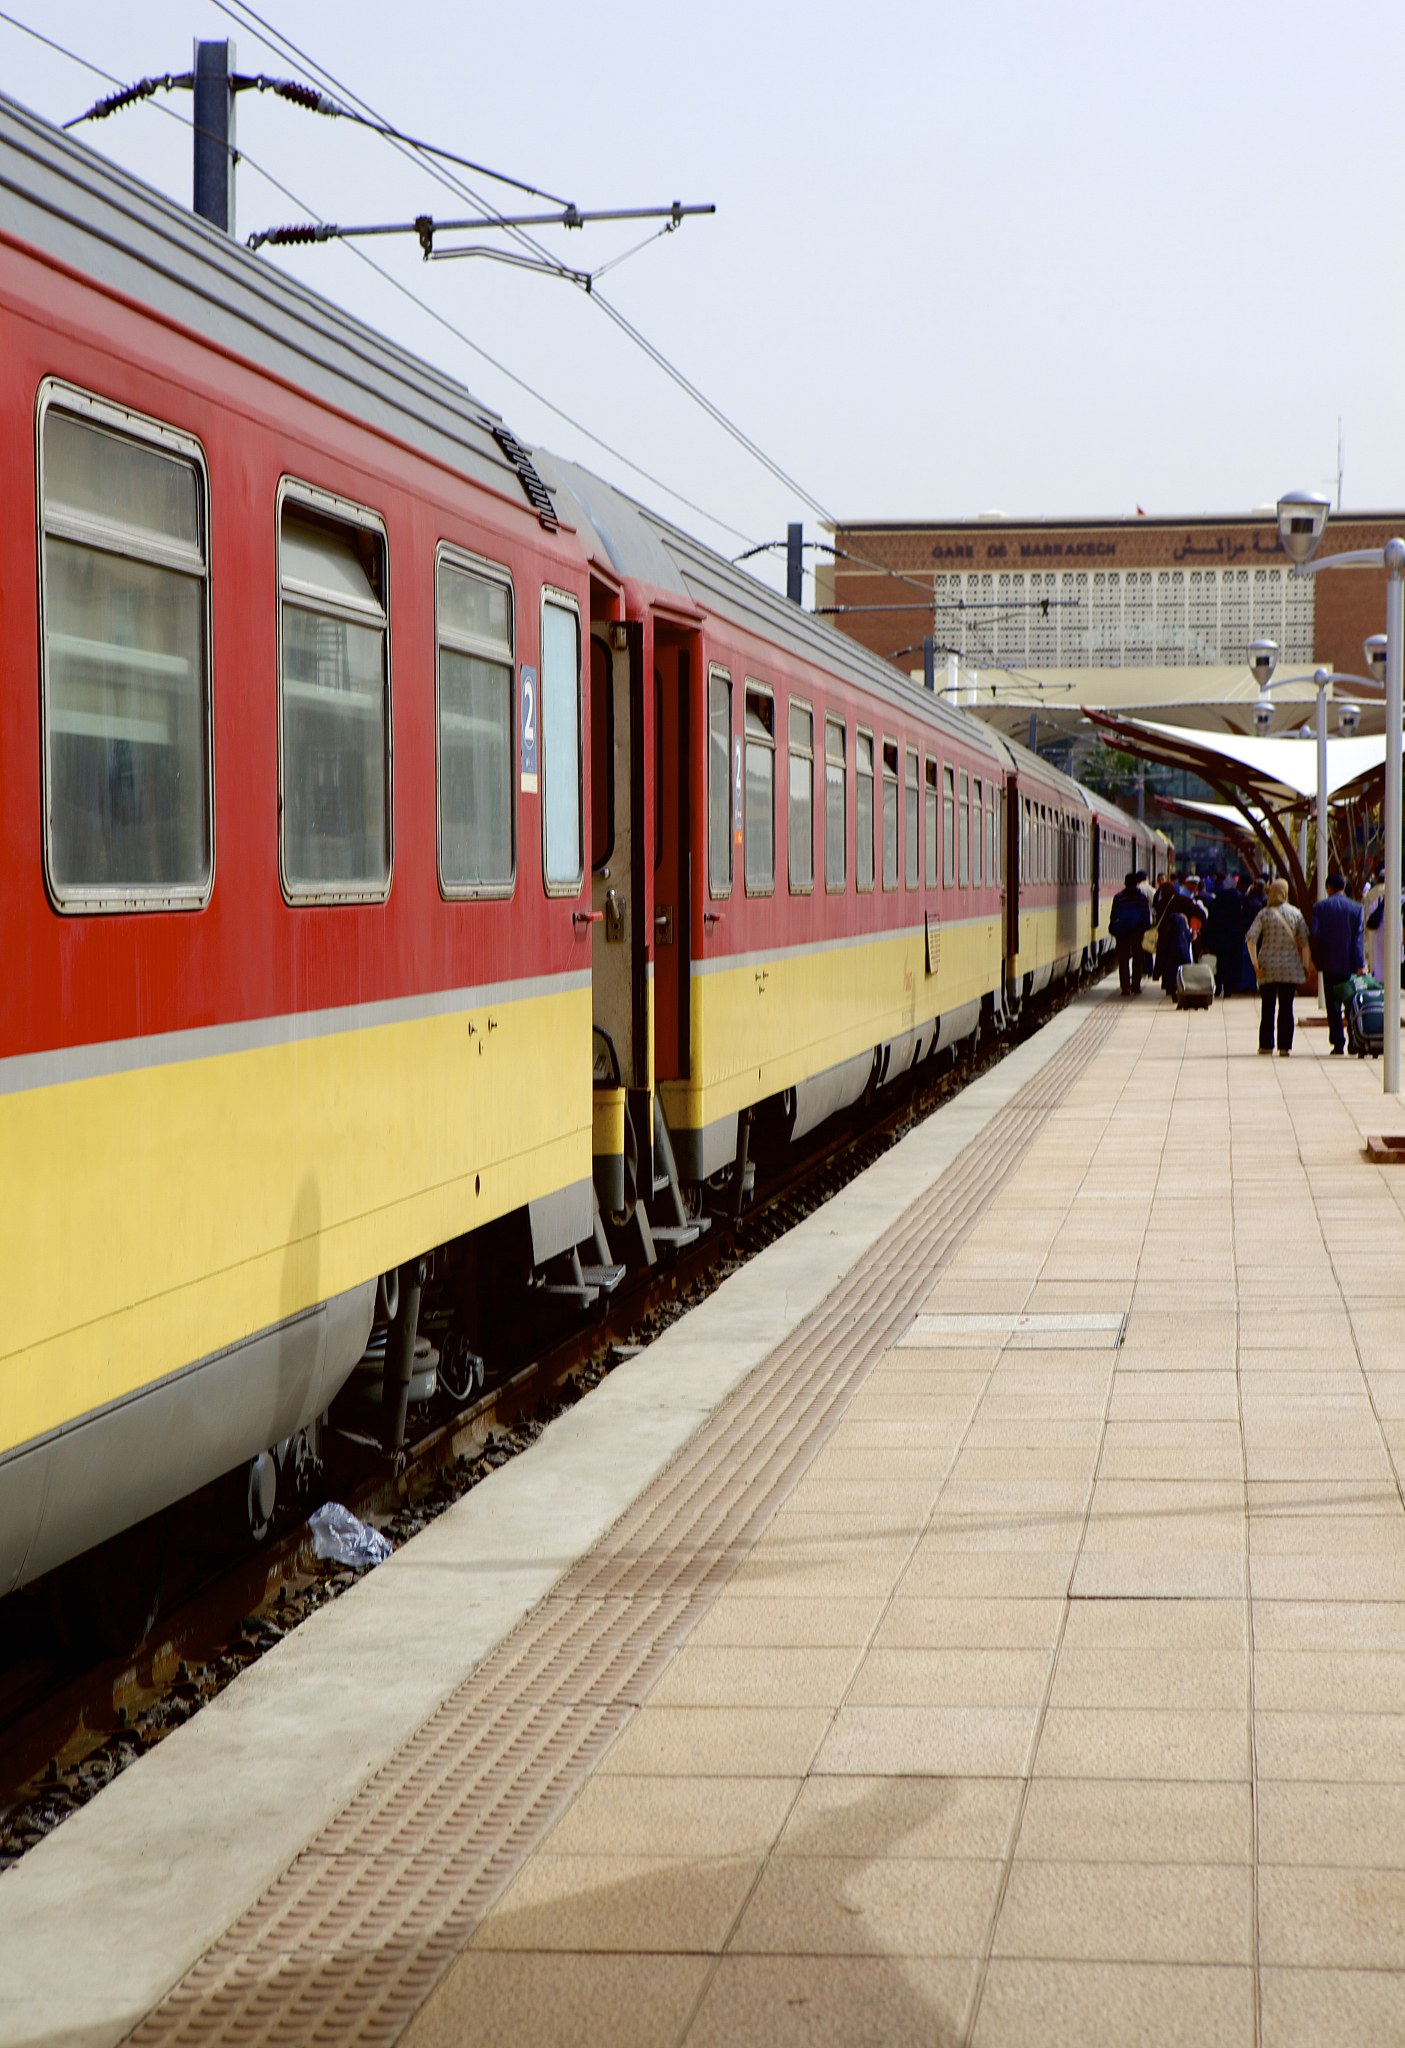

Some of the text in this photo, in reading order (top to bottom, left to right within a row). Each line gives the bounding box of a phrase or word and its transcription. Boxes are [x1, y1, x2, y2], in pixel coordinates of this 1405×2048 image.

[932, 542, 1116, 559] GARE DE MARRAKECH
[524, 680, 534, 740] 2
[736, 744, 741, 788] 2
